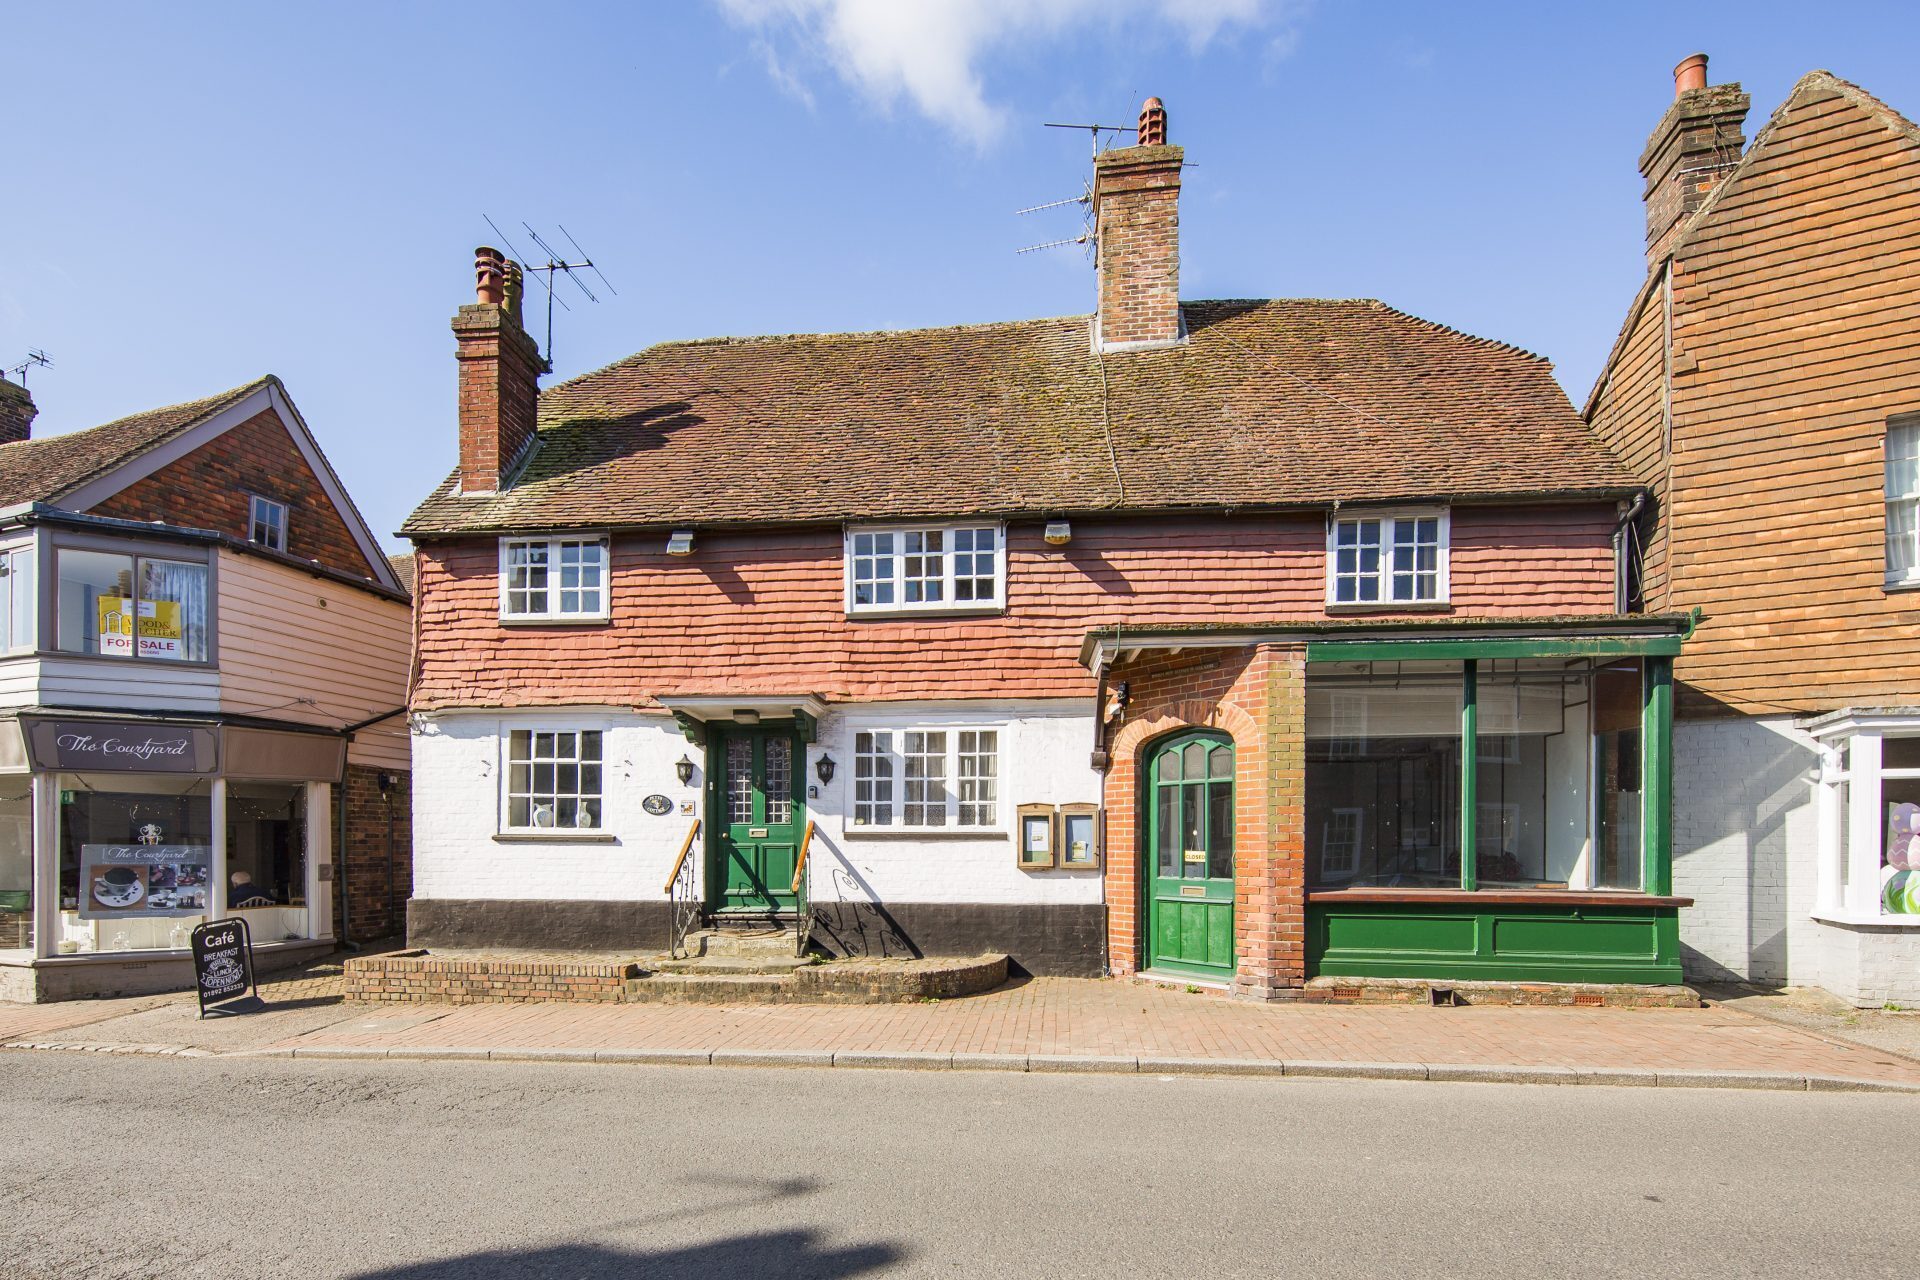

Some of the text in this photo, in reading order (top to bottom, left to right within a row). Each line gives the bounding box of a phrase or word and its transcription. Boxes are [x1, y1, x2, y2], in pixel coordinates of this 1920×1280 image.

[140, 640, 175, 651] SALE
[57, 734, 188, 760] The Courtyard
[108, 847, 187, 862] The Courtyard
[205, 931, 235, 947] Café
[203, 947, 239, 962] BREAKFAST
[207, 971, 240, 987] OPEN NOW
[213, 967, 232, 977] LUNCH
